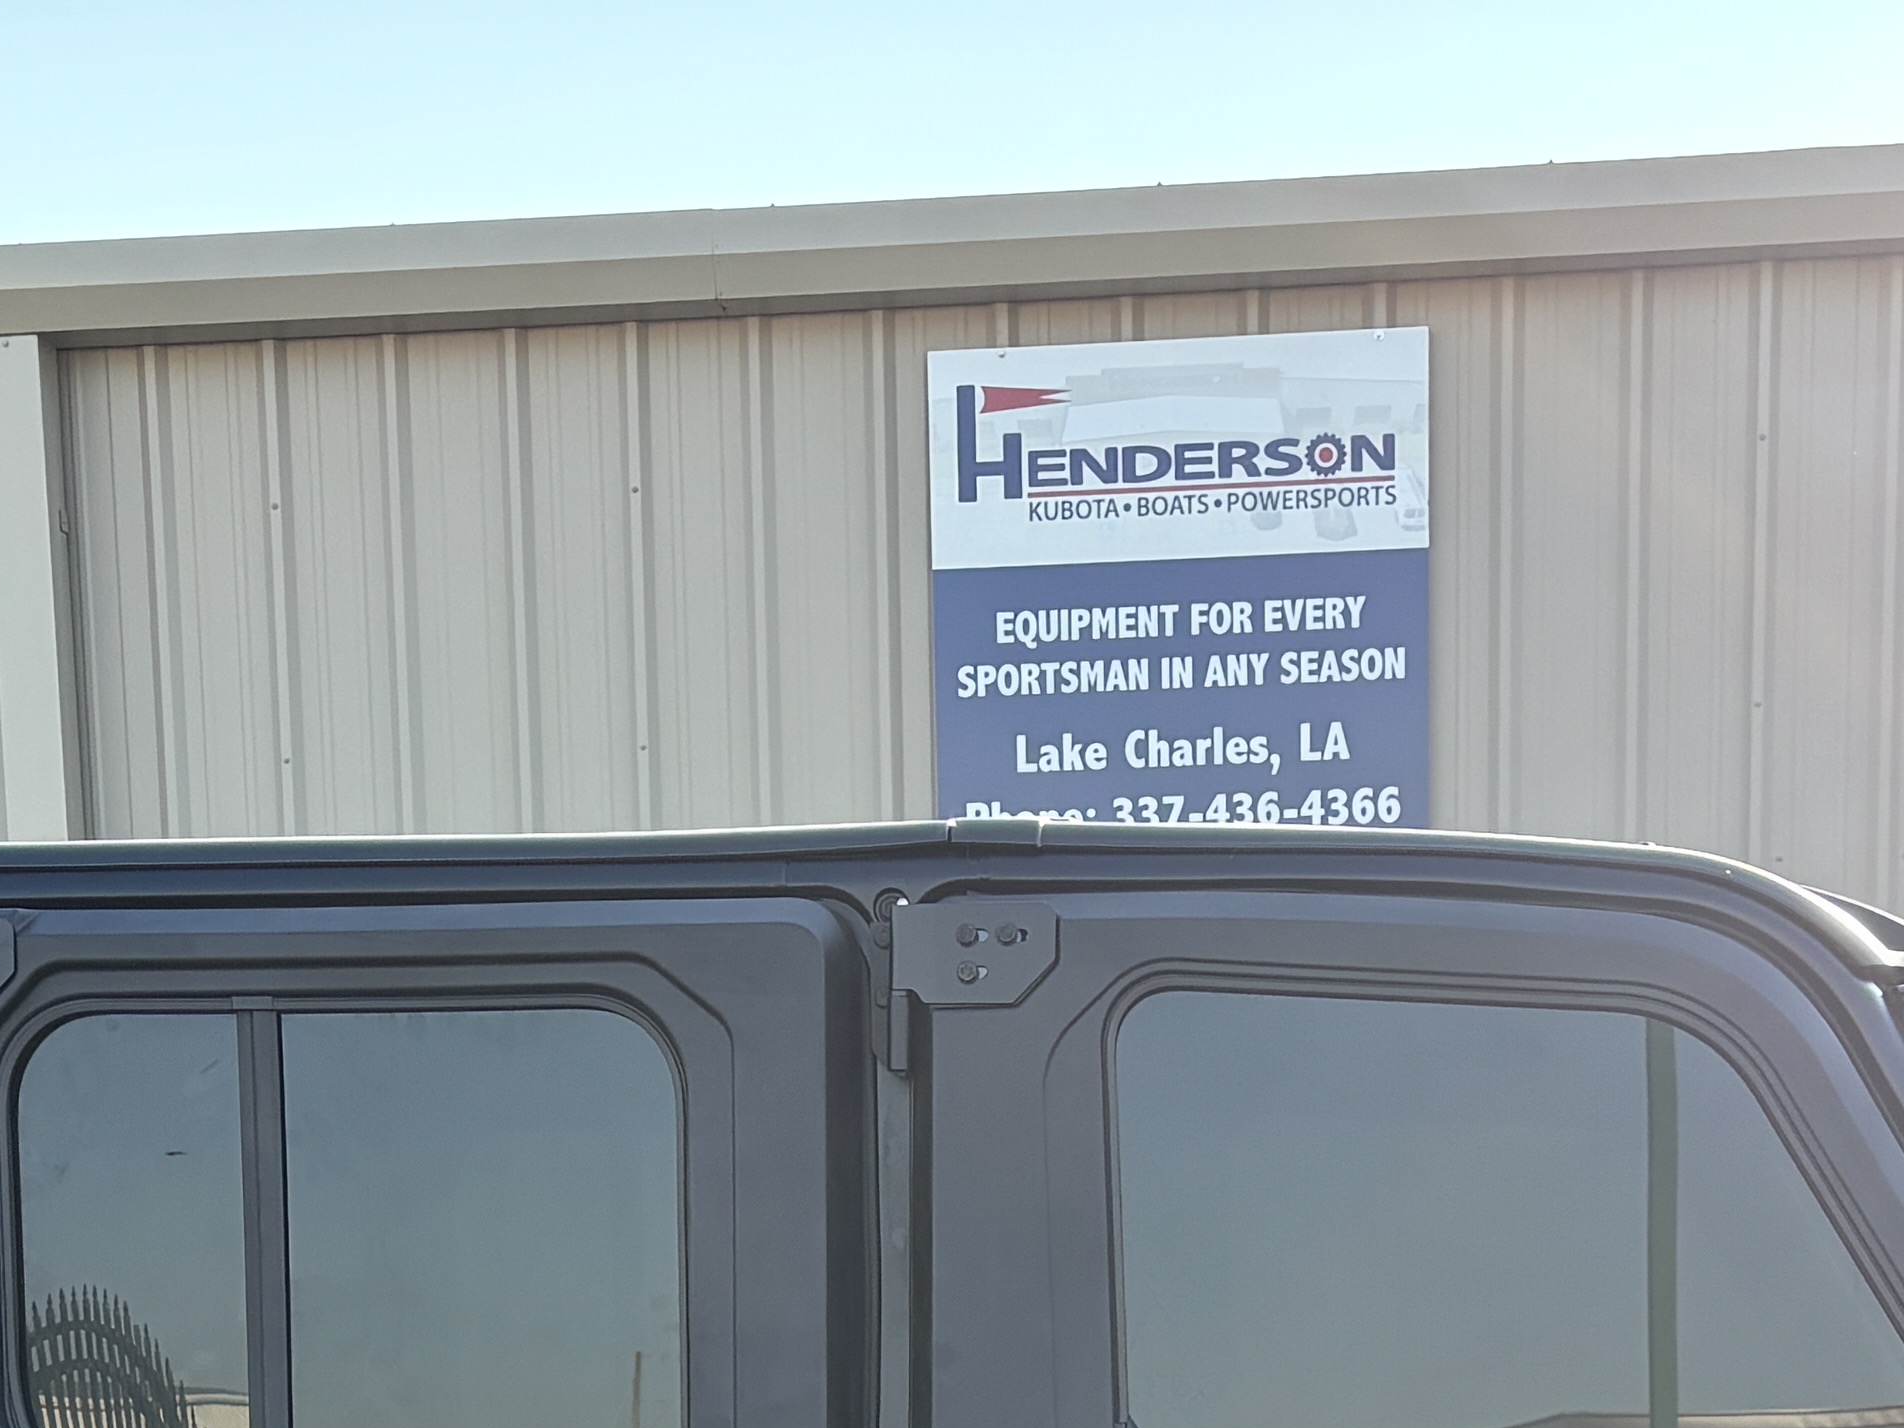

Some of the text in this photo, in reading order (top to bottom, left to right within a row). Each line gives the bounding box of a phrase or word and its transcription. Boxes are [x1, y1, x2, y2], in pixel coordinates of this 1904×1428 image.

[956, 384, 1396, 503] HENDERSON
[1028, 485, 1397, 522] KUBOTA BOATS POWERSPORTS
[996, 596, 1366, 648] EQUIPMENT FOR EVERY
[957, 647, 1406, 698] SPORTSMAN IN ANY SEASON
[1016, 722, 1350, 774] Lake Charles, LA
[1112, 786, 1402, 826] 337-436-4366
